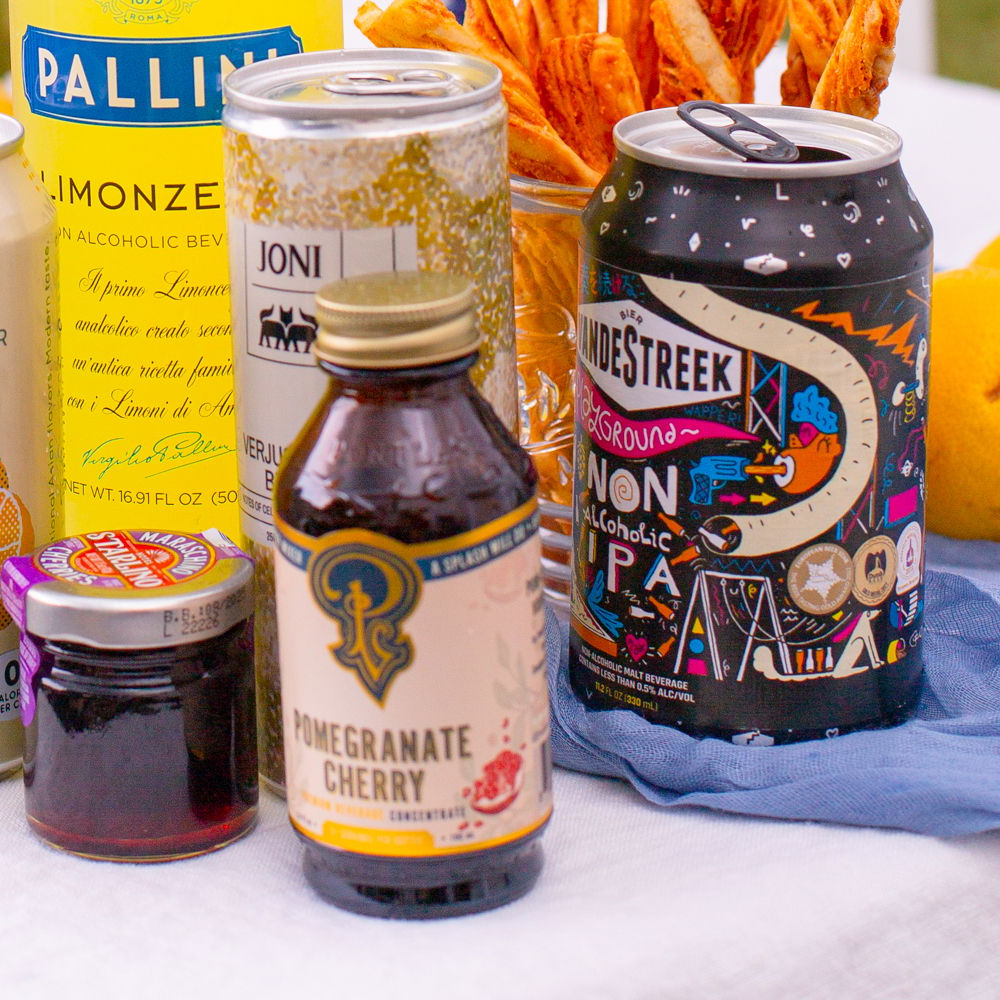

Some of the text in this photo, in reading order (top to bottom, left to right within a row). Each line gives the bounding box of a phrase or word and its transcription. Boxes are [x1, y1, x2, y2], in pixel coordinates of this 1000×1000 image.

[130, 13, 162, 21] ROMA
[38, 47, 277, 109] PALLIN
[77, 230, 179, 249] ALCOHOLIC
[187, 233, 223, 248] BEV
[256, 239, 322, 278] JONI
[99, 280, 145, 302] primo
[619, 309, 644, 326] BIER
[67, 395, 85, 409] con
[91, 395, 98, 412] i
[102, 388, 169, 419] Limoni
[173, 397, 191, 418] di
[64, 478, 87, 496] NET
[90, 485, 115, 502] WT.
[117, 490, 150, 504] 16.91
[155, 492, 174, 506] FL
[178, 492, 202, 506] OZ
[588, 450, 679, 517] NON
[40, 546, 98, 585] CHERRIES
[86, 532, 162, 587] STARLINO
[140, 531, 208, 575] MARASCHINO
[5, 660, 20, 686] 0
[579, 654, 696, 704] CONTAINS LESS THAN 0.5% ALC/VOL
[624, 667, 643, 681] MALT
[645, 672, 689, 691] BEVERAGE
[605, 686, 613, 697] FL
[294, 708, 472, 763] POMEGRANATE
[324, 760, 425, 804] CHERRY
[389, 806, 467, 822] CONCENTRATE
